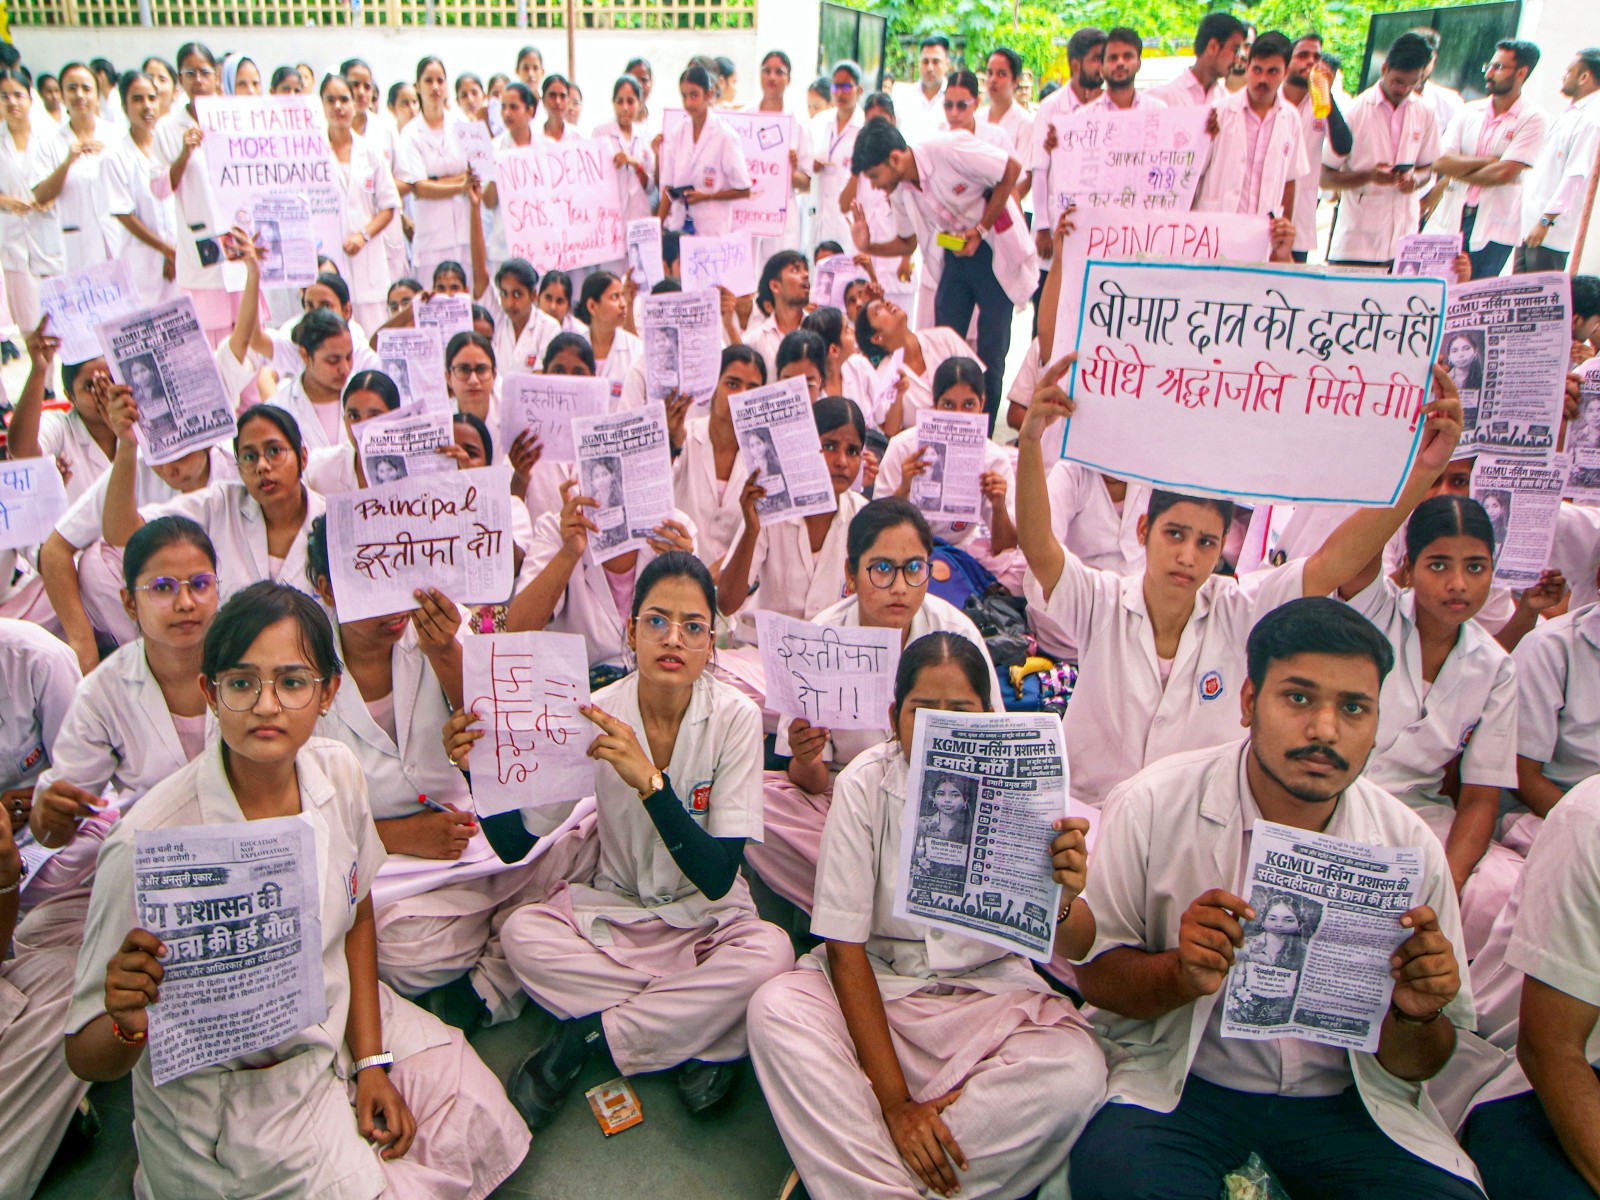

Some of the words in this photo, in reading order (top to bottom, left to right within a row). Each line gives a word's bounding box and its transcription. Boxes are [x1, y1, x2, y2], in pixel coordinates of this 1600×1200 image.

[207, 110, 241, 132] LIFE
[228, 136, 277, 159] MORE
[220, 161, 331, 187] ATTENDANCE
[499, 156, 544, 191] NOW
[547, 148, 603, 190] DEAN
[1513, 295, 1549, 308] प्रशासन
[1090, 281, 1180, 347] बीमार
[1254, 289, 1304, 351] को
[1384, 296, 1441, 359] नहीं
[1082, 344, 1156, 401] सीधे
[1157, 358, 1297, 414] श्रद्धांजलि
[520, 386, 577, 412] इस्तीफा
[581, 430, 609, 445] KGMU
[1480, 466, 1508, 477] KGMU
[355, 486, 477, 521] Principal
[353, 532, 460, 580] इस्तीफा
[777, 628, 888, 673] इस्तीफा
[791, 671, 829, 721] दो
[471, 641, 538, 785] इस्तीफा
[932, 738, 977, 755] KGMU
[978, 740, 1012, 757] नर्सिंग
[1013, 744, 1047, 757] प्रशासन
[1048, 739, 1056, 755] से
[933, 757, 977, 773] हमारी
[986, 779, 1003, 787] हमारी
[1004, 780, 1020, 790] प्रमुख
[157, 843, 172, 853] चली
[240, 838, 278, 848] EDUCATION
[240, 847, 290, 859] EXPLOITATION
[152, 855, 166, 863] कब
[166, 852, 190, 863] जागेगी
[145, 874, 160, 886] और
[161, 871, 191, 887] अनसुनी
[1265, 850, 1315, 875] KGMU
[1317, 863, 1354, 884] नर्सिंग
[1357, 873, 1396, 891] प्रशासन
[1396, 877, 1410, 892] की
[1257, 867, 1324, 896] संवेदनहीनता
[1326, 883, 1339, 899] से
[1341, 888, 1366, 904] छात्रा
[1367, 890, 1381, 906] की
[1381, 895, 1393, 910] हुई
[1393, 893, 1409, 908] मौत
[174, 893, 253, 926] प्रशासन
[256, 881, 284, 910] की
[206, 925, 233, 952] की
[234, 919, 259, 953] हुई
[262, 912, 296, 940] मौत
[196, 979, 205, 988] की
[206, 977, 226, 987] द्वितीय
[1253, 965, 1275, 978] दिव्यांशी
[1276, 970, 1292, 979] यादव
[171, 1000, 188, 1010] अपनी
